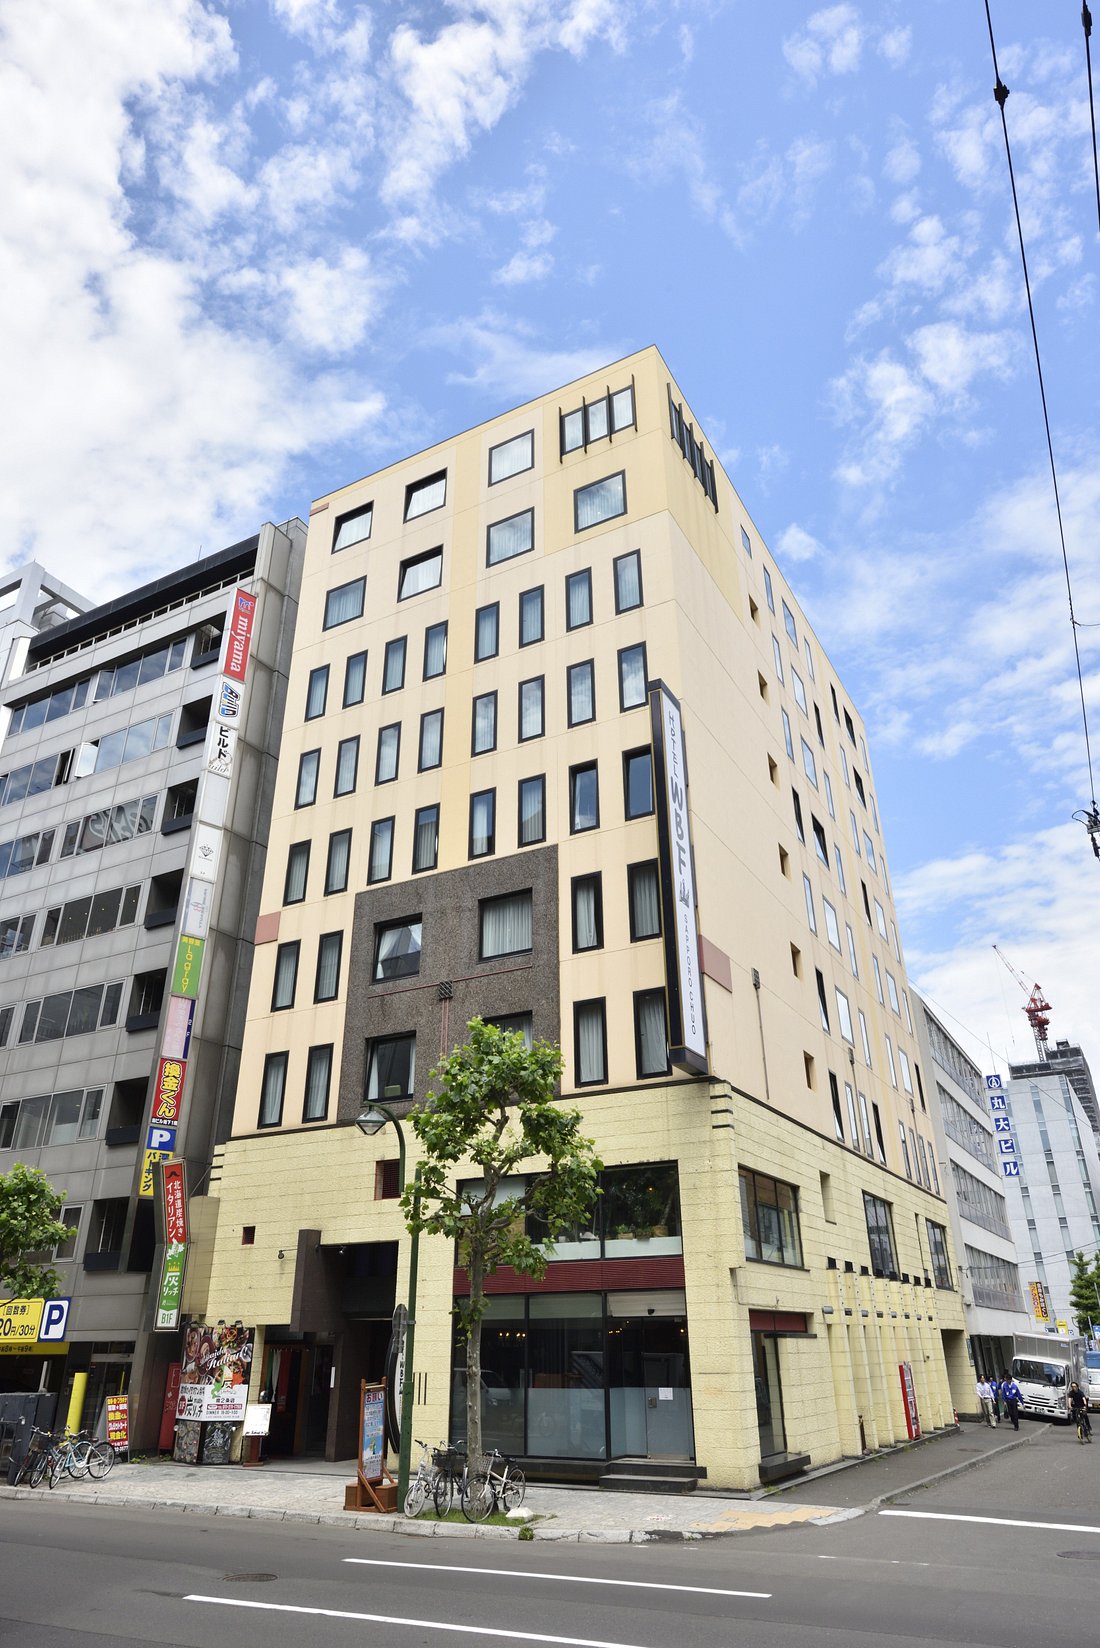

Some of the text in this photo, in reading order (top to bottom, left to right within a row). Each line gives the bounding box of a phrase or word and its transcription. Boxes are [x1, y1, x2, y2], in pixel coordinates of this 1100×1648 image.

[230, 615, 251, 672] miyama
[217, 726, 230, 760] ビルド
[668, 710, 679, 779] HOTEL
[671, 776, 687, 875] WBF
[683, 914, 693, 988] SAPPORO
[157, 1061, 182, 1118] 換金くん
[150, 1129, 171, 1148] P
[991, 1096, 1018, 1176] 丸大ビル
[142, 1151, 157, 1192] パーキング
[165, 1182, 177, 1238] イタリアン
[43, 1304, 65, 1335] P
